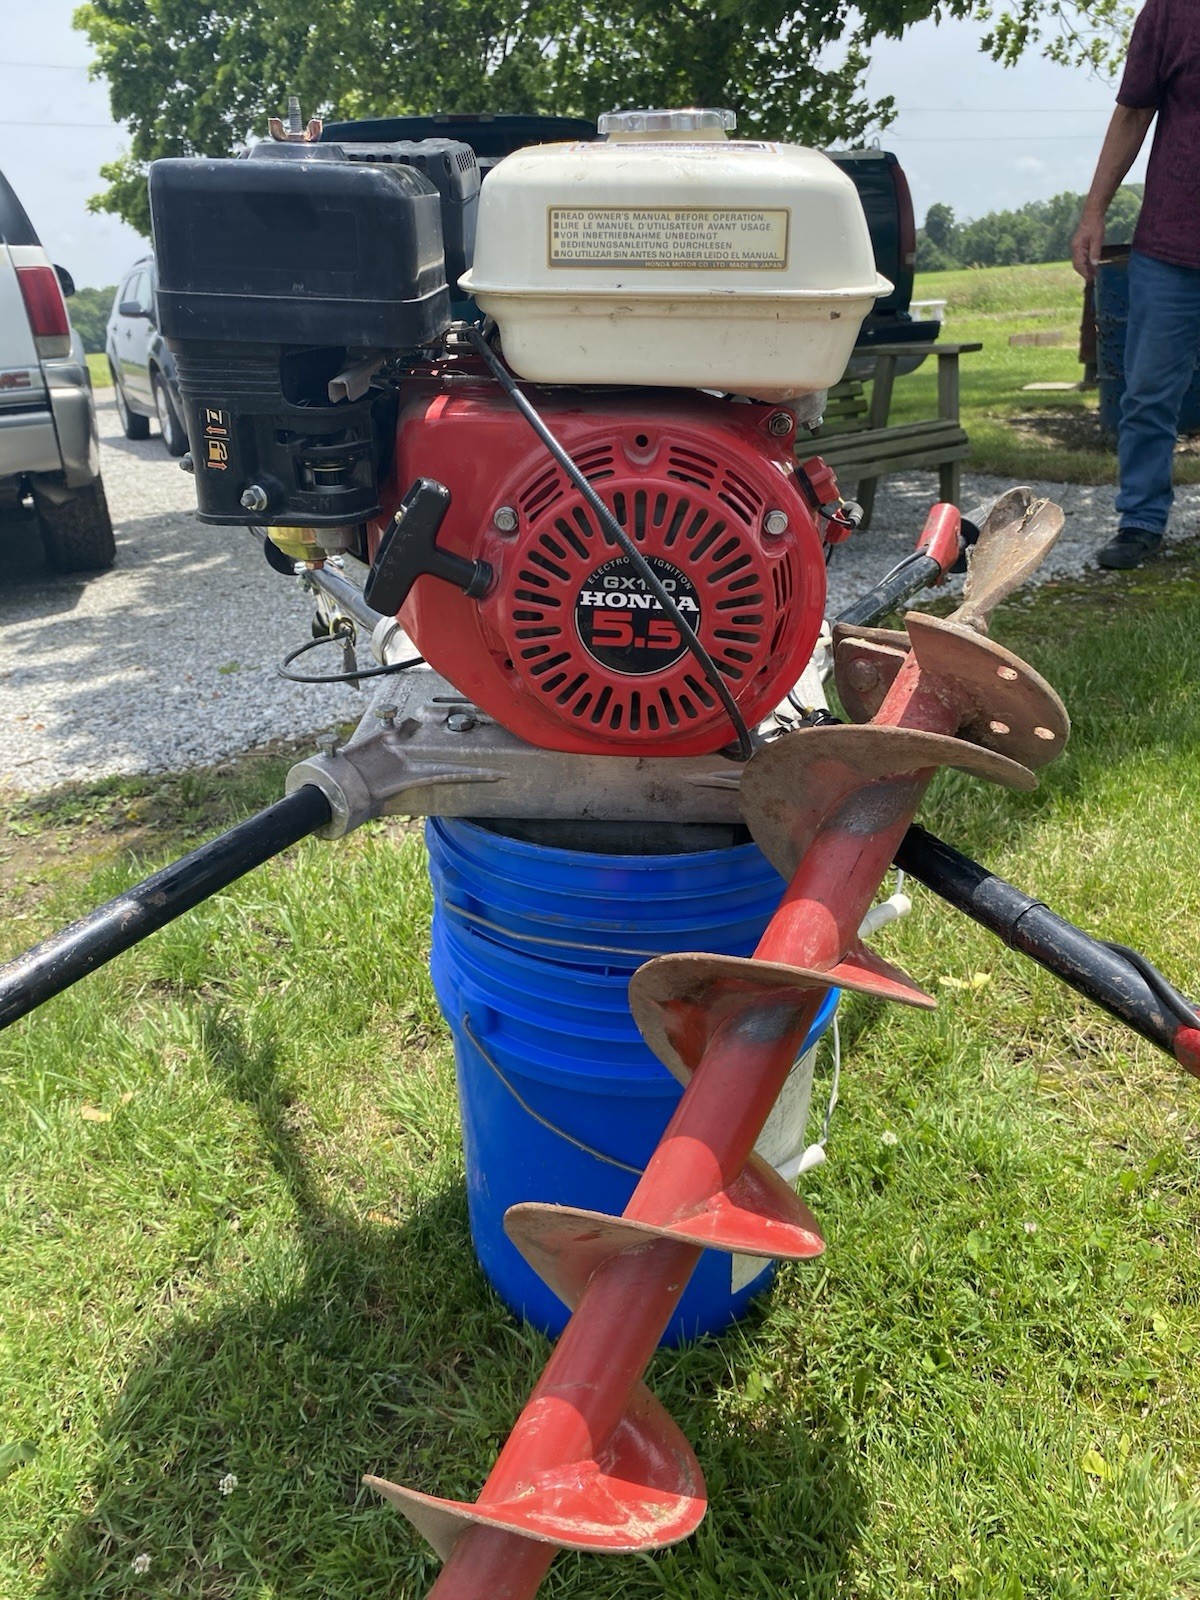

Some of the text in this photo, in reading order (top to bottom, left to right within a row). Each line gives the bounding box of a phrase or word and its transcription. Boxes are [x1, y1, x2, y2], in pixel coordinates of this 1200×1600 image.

[560, 212, 585, 220] READ
[587, 212, 630, 221] OWNER'S
[632, 213, 671, 221] MANUAL
[674, 213, 709, 221] BEFORE
[560, 221, 580, 230] LIRE
[583, 221, 593, 230] LE
[596, 222, 634, 230] MANUEL
[637, 222, 704, 231] D'UTILISATEUR
[707, 223, 737, 231] AVANT
[560, 231, 718, 240] VOR INBETRIEBNAHME UNBEDINGT
[560, 240, 669, 249] BEDIENUNGSANLEITUNG
[560, 250, 574, 258] NO
[575, 250, 612, 258] UTILIZAR
[629, 251, 657, 259] ANTES
[658, 251, 672, 259] NO
[673, 251, 703, 259] HABER
[703, 252, 730, 260] LEIDO
[730, 252, 740, 260] EL
[760, 261, 783, 269] JAPAN
[587, 555, 692, 590] ELECTROC IGNITION
[603, 575, 677, 592] GX10
[591, 610, 682, 650] 5.5
